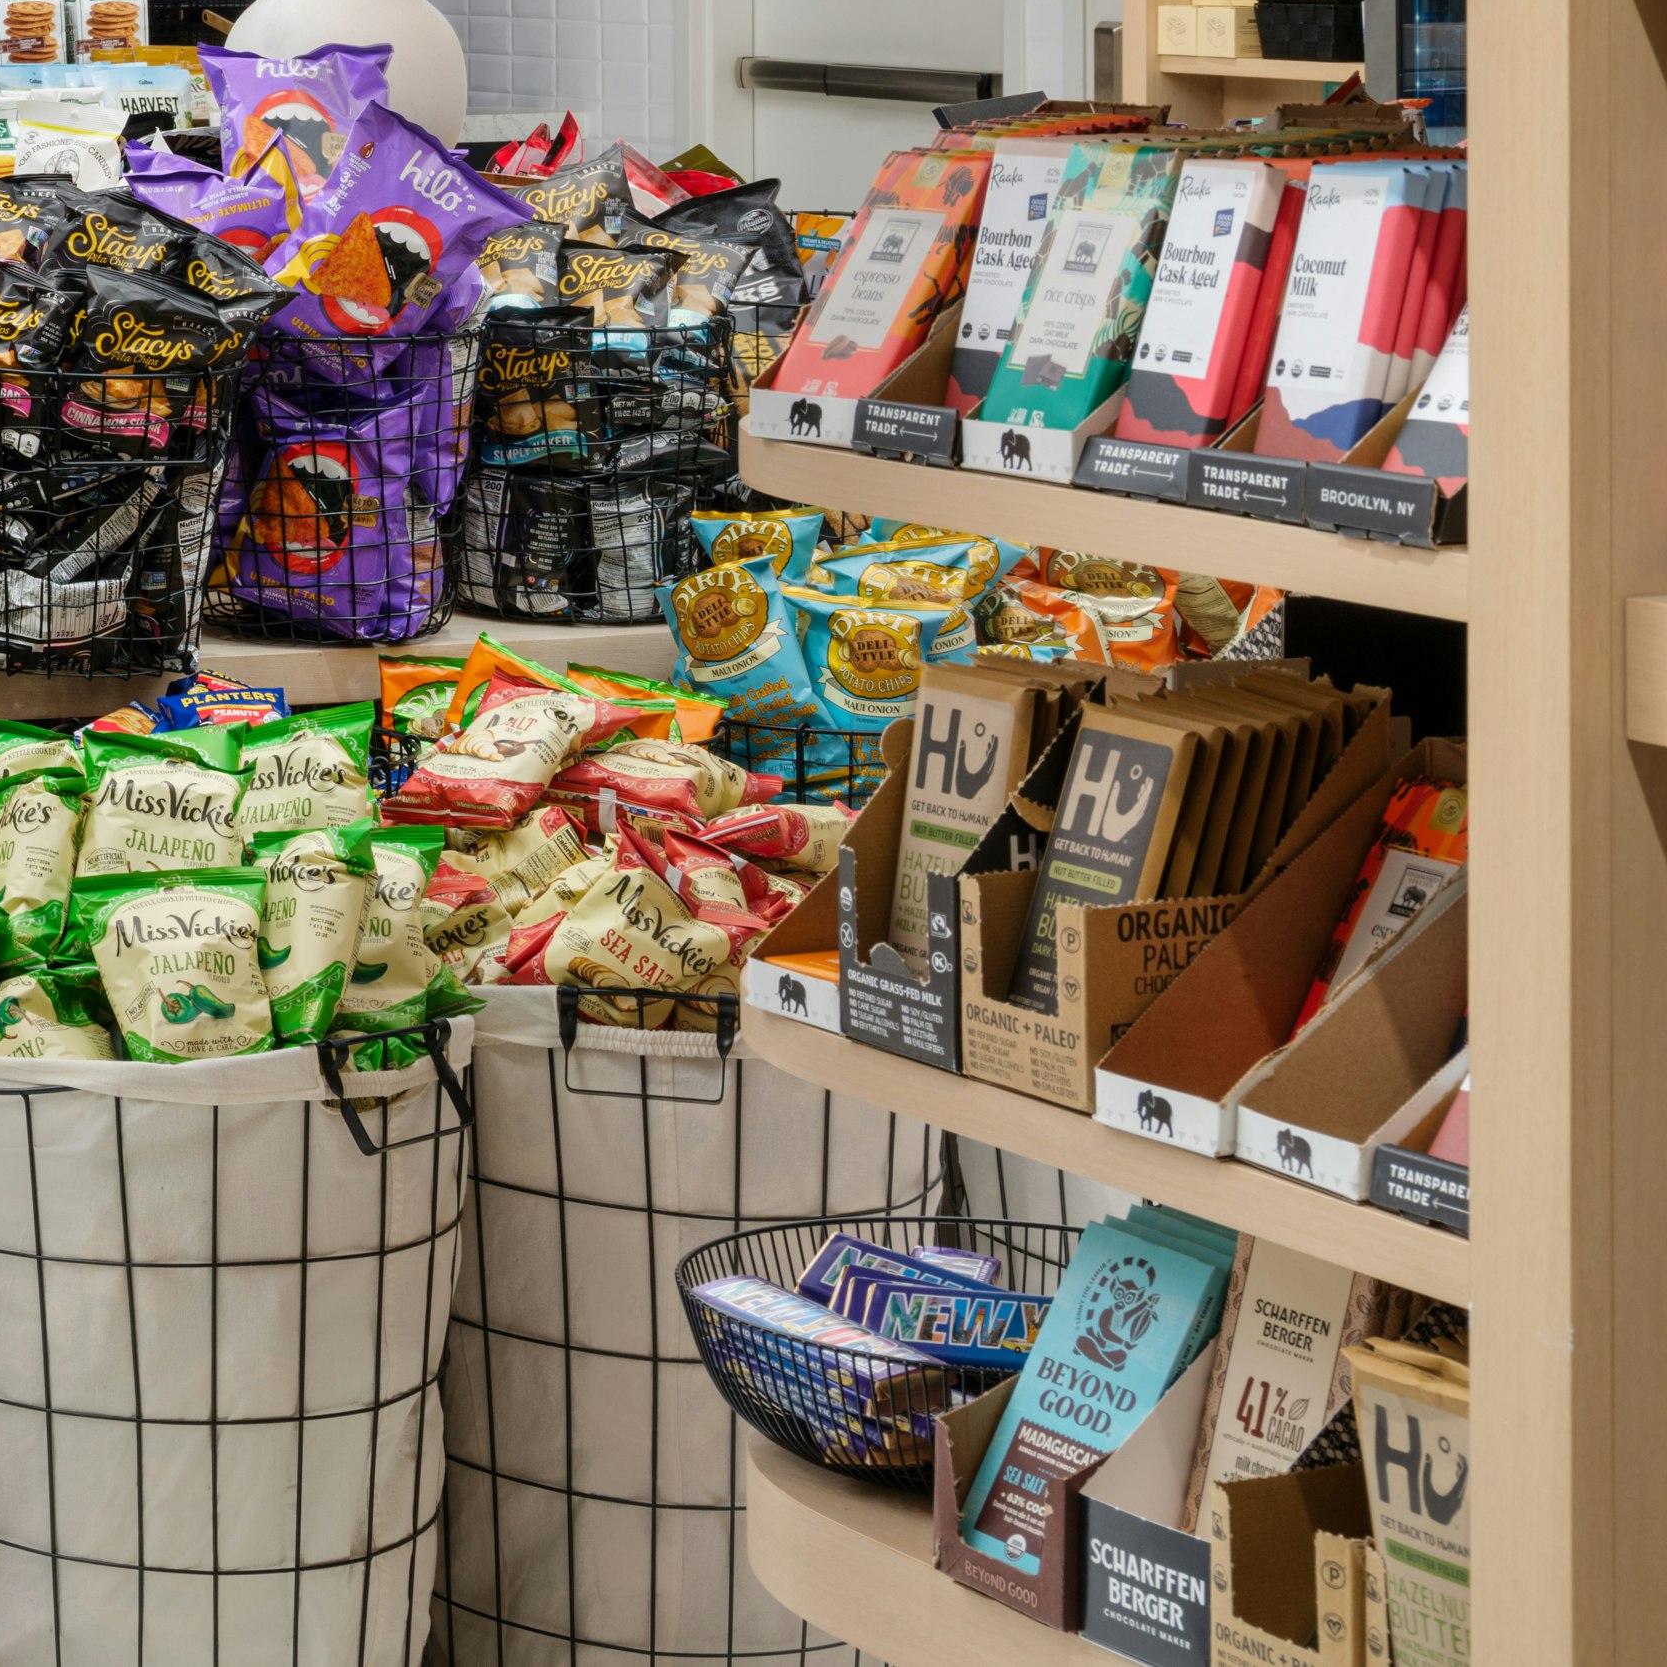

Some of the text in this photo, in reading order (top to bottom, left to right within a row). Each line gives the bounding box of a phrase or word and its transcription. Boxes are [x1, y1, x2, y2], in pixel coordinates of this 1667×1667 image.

[121, 96, 179, 115] HARVEST
[399, 150, 463, 212] hilo
[1164, 242, 1215, 266] Bourbon
[1295, 254, 1347, 276] Coconut
[559, 249, 656, 296] Stacy's
[1158, 264, 1220, 290] Cask Aged
[1292, 276, 1318, 297] Milk
[95, 311, 196, 371] Stacy's
[865, 421, 897, 435] TRADE
[867, 404, 941, 426] TRANSPARENT
[1203, 466, 1288, 491] TRANSPARENT
[1203, 484, 1240, 501] TRADE
[1320, 488, 1415, 516] BROOKLYN, NY
[853, 651, 896, 662] STYLE
[856, 639, 889, 650] DELI
[837, 664, 913, 693] POTATO CHIPS
[181, 691, 277, 707] PLANTERS
[843, 698, 901, 714] MAUI ONION
[212, 709, 260, 718] PEANUTS
[125, 829, 215, 862] JALAPEÑO
[1054, 838, 1069, 851] GET
[1070, 841, 1090, 856] BACK
[116, 915, 178, 957] Miss
[599, 928, 633, 965] SEA
[149, 950, 235, 977] JALAPEÑO
[847, 969, 942, 1008] ORGANIC GRASS-FED MILK
[1037, 1356, 1137, 1414] BEYOND
[1039, 1389, 1112, 1434] GOOD
[1266, 1416, 1305, 1453] CACAO
[1003, 1465, 1047, 1496] SEA SALT
[1090, 1537, 1206, 1607] SCHARFFEN
[1108, 1576, 1185, 1631] BERGER
[1103, 1608, 1191, 1650] CHOCOLATE MAKER
